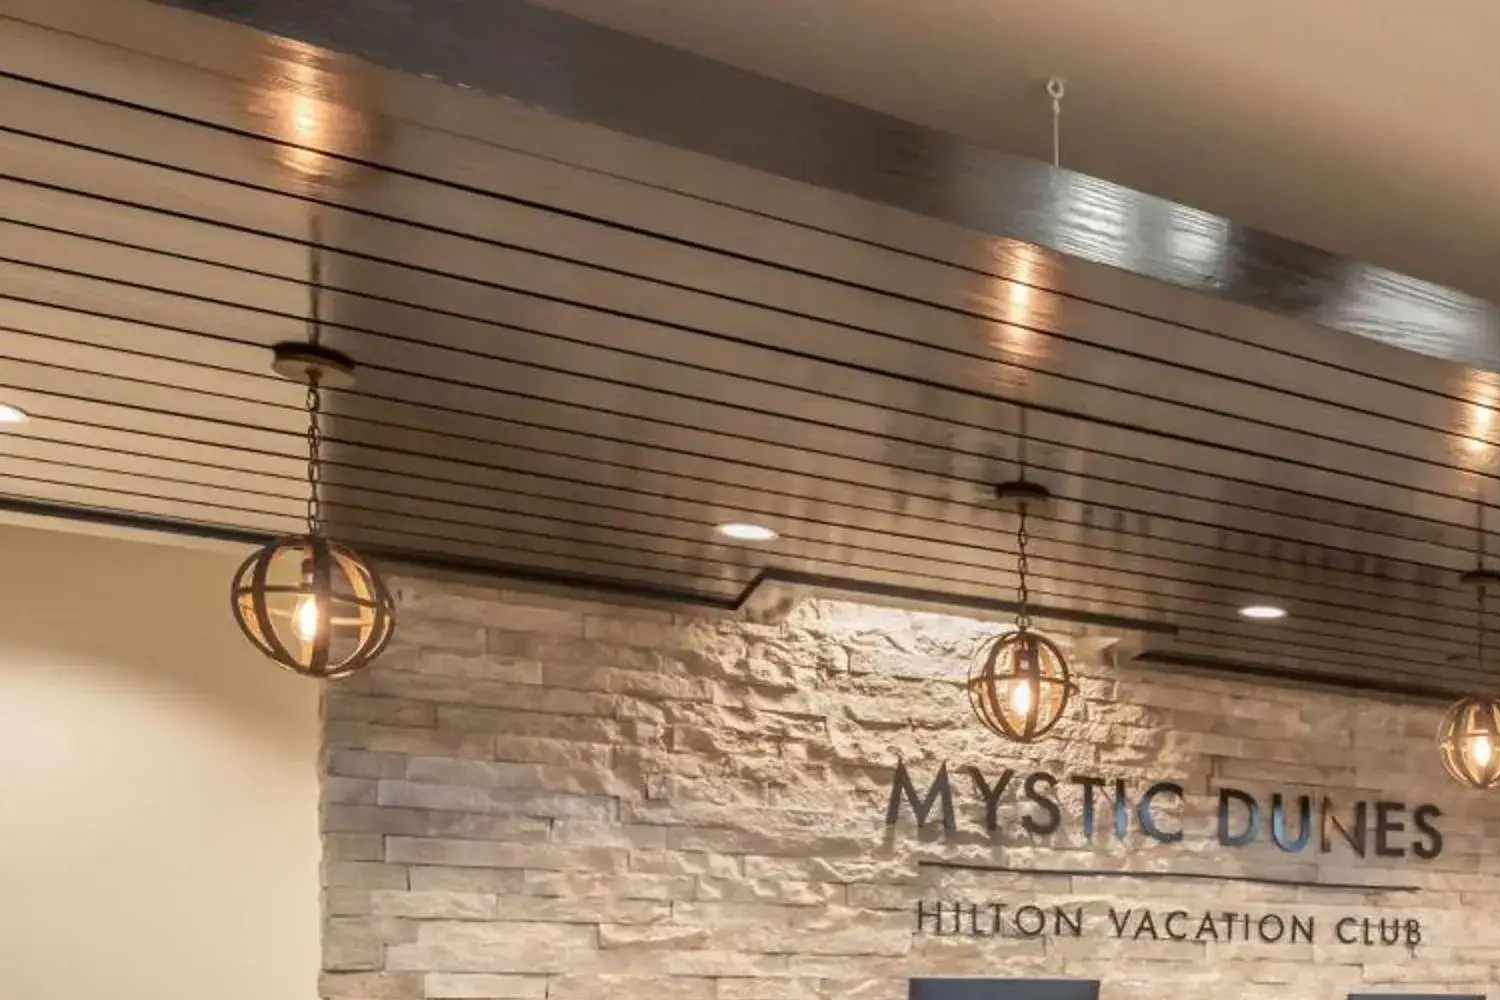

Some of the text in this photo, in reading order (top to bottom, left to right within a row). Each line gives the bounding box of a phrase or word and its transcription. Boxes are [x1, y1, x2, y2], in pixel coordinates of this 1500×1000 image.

[886, 756, 1443, 859] MYSTIC DUNES
[917, 901, 1423, 946] HILTON VACATION CLUB
